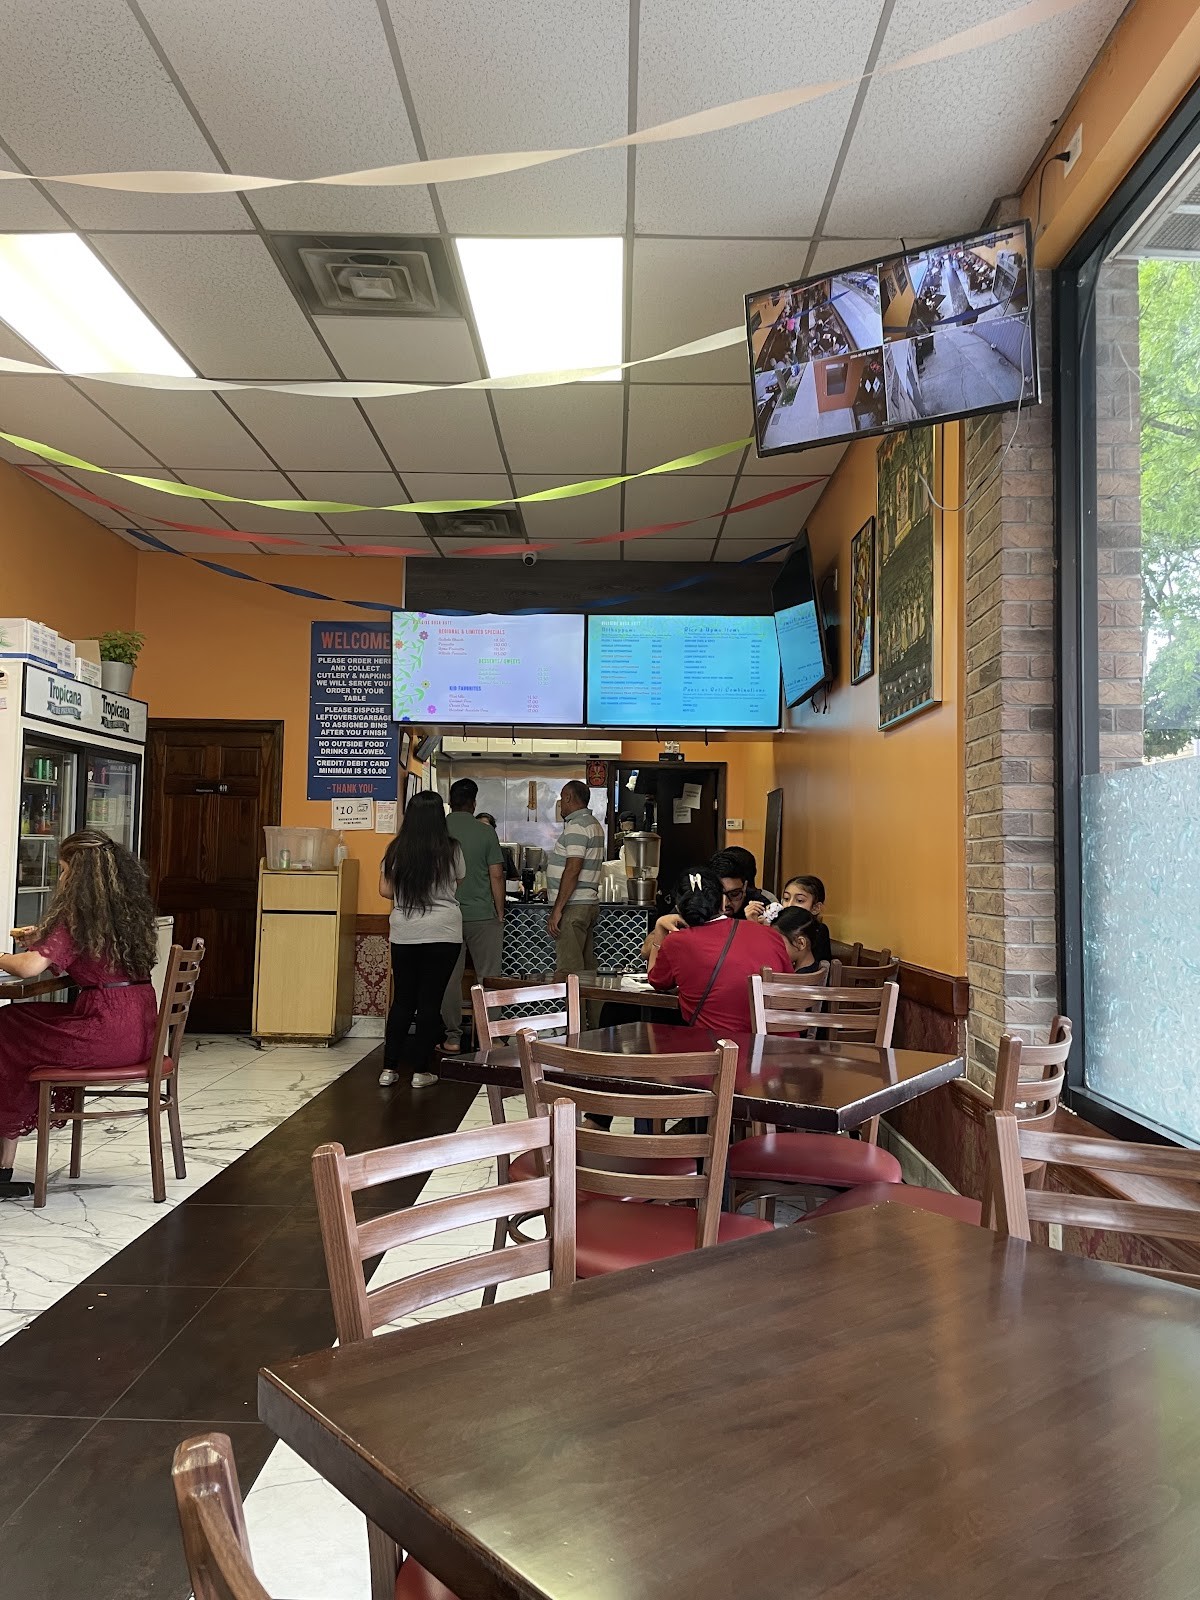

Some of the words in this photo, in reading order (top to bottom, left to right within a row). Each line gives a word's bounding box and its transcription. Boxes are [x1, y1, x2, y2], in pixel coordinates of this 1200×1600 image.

[321, 632, 391, 649] WELCOME
[48, 677, 81, 706] Tropicana
[102, 694, 129, 719] Tropicana
